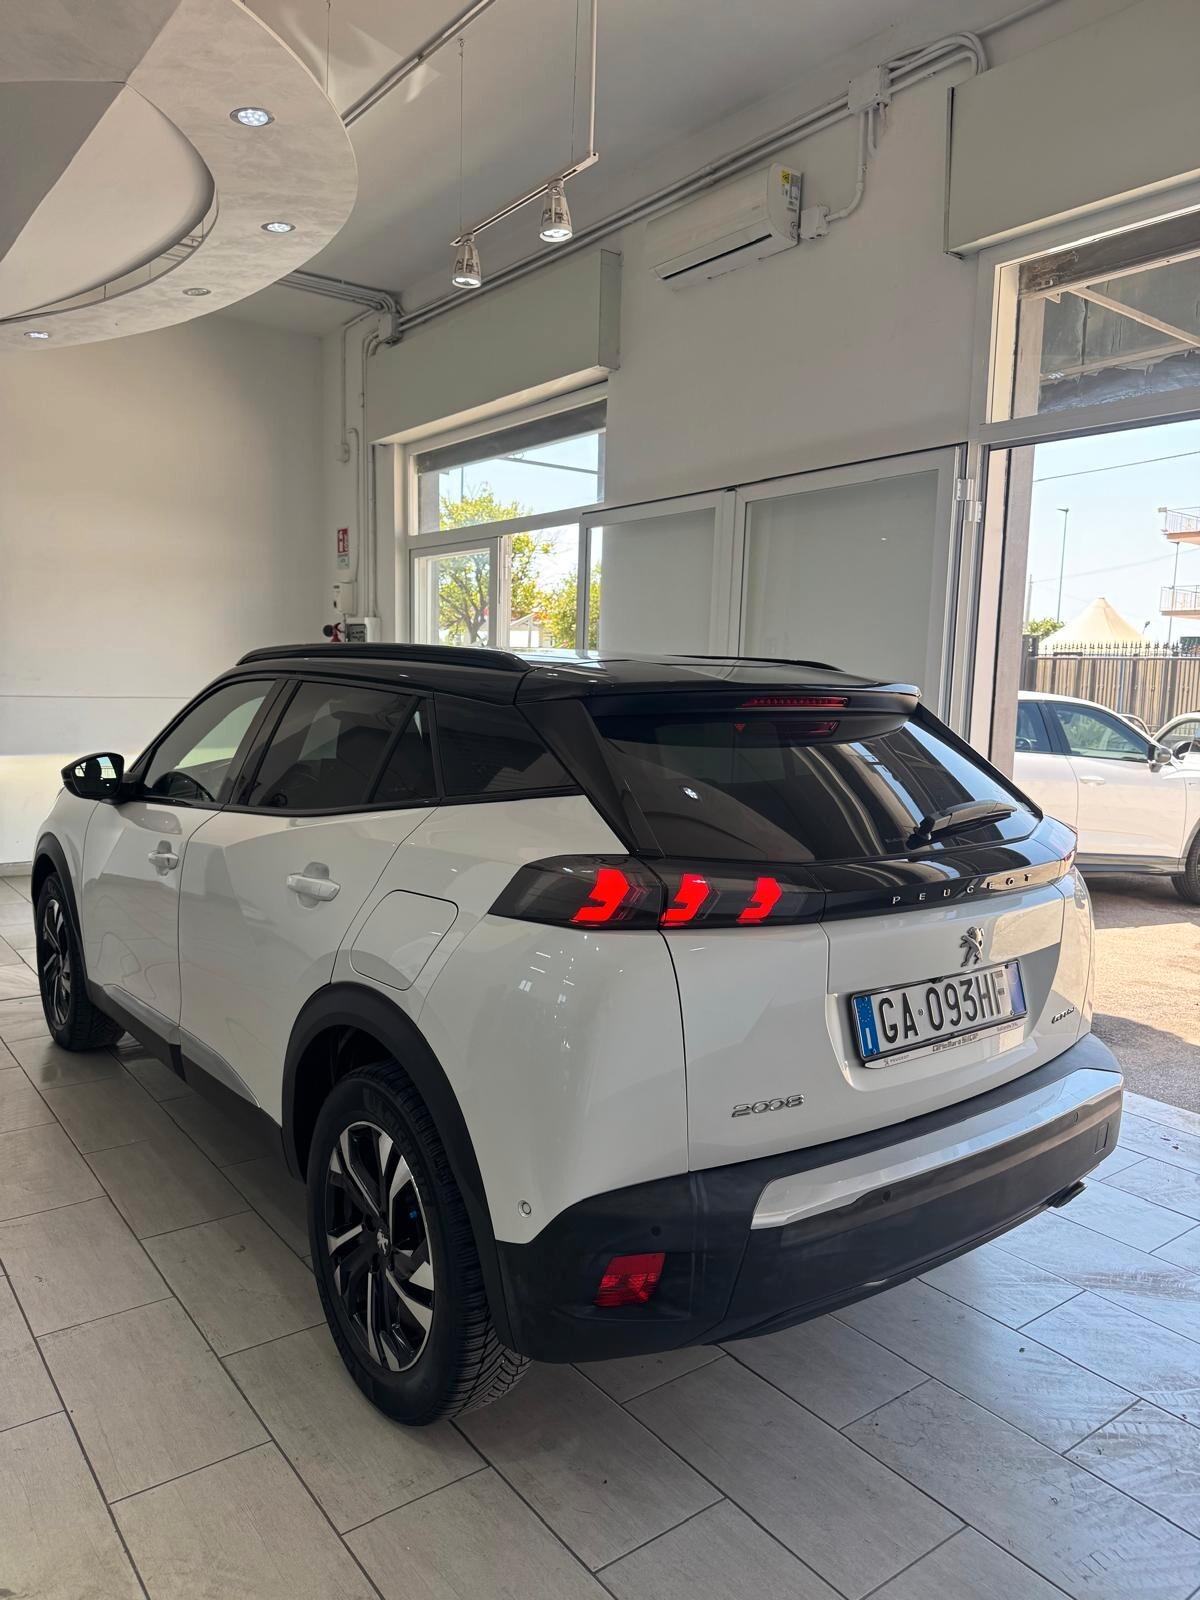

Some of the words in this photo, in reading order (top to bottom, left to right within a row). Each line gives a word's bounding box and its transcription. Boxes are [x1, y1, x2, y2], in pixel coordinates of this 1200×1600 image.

[892, 873, 1032, 904] PEUGEOT
[879, 993, 919, 1043] GA
[926, 970, 1005, 1031] 093HF
[731, 1094, 804, 1117] 2008
